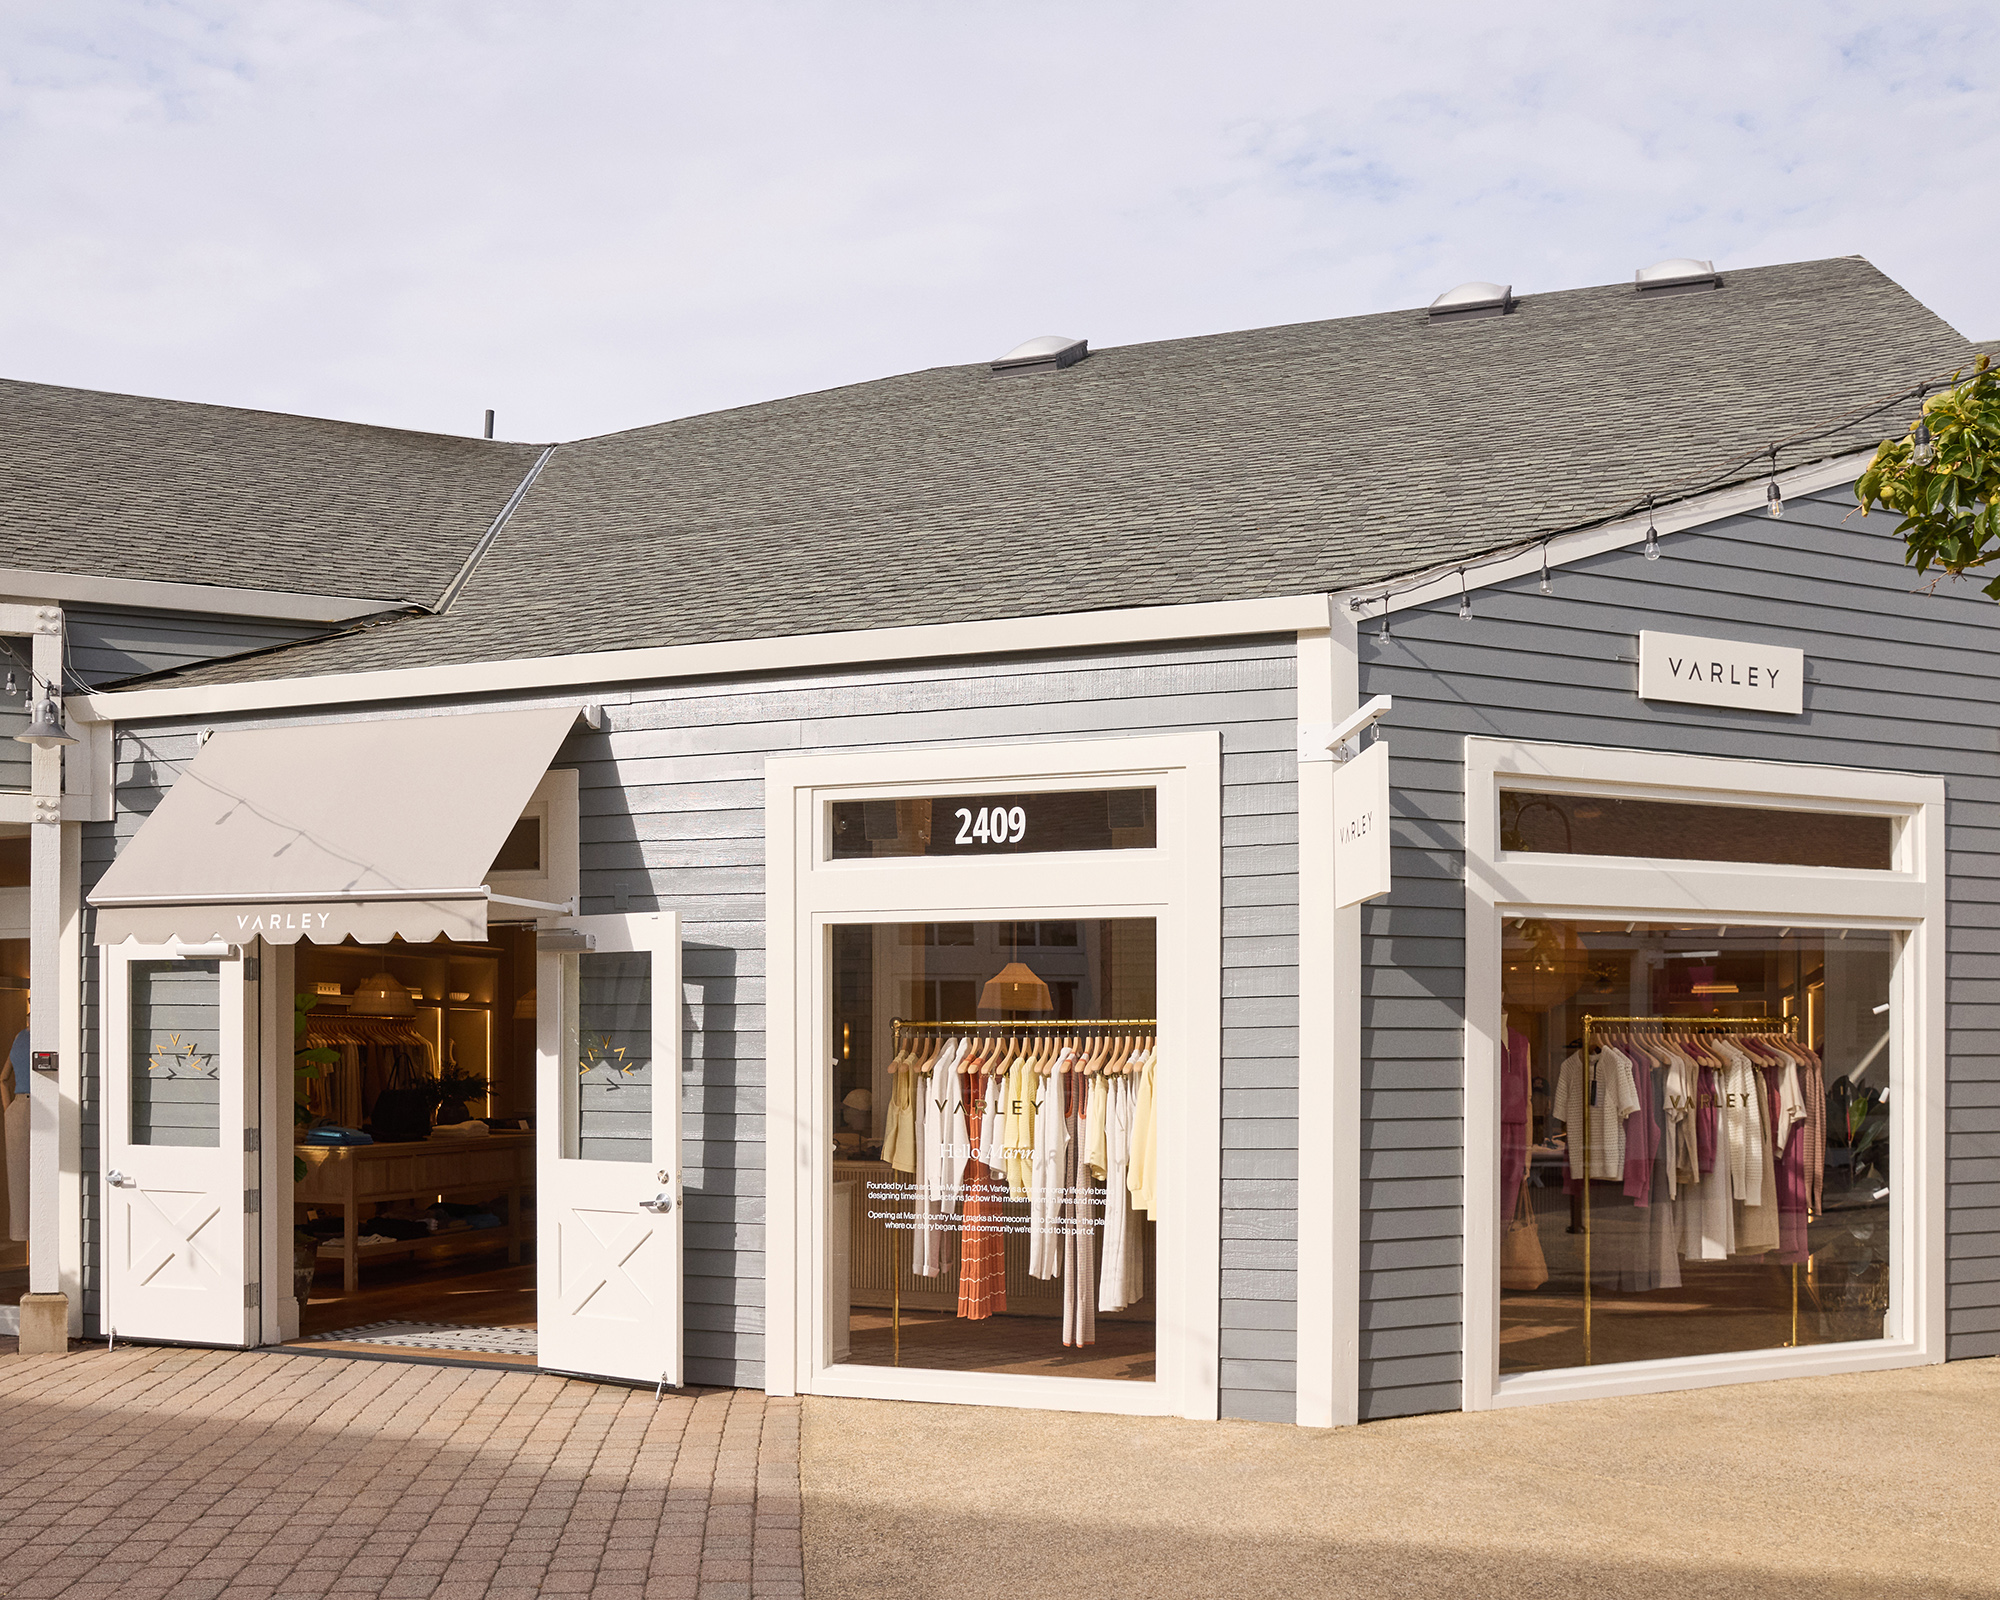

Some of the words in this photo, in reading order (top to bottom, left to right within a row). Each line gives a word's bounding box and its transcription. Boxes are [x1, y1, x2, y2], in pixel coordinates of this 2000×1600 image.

[1668, 657, 1780, 689] VARLEY
[954, 806, 1027, 845] 2409
[1339, 811, 1373, 844] VARLEY
[236, 912, 330, 930] VARLEY
[934, 1099, 1044, 1116] VARLEY
[1669, 1093, 1750, 1109] VARLEY
[940, 1143, 980, 1160] Hello
[866, 1181, 895, 1190] Founded
[895, 1182, 904, 1192] by
[965, 1184, 972, 1192] in
[972, 1184, 990, 1193] 2014,
[990, 1185, 1010, 1194] Varley
[868, 1191, 900, 1202] designing
[991, 1195, 1002, 1203] the
[1003, 1195, 1029, 1203] modern
[1057, 1197, 1073, 1205] lives
[868, 1210, 895, 1220] Opening
[903, 1211, 921, 1220] Marin
[949, 1213, 965, 1221] Mart
[992, 1214, 1034, 1224] homecomin
[1082, 1217, 1093, 1226] the
[885, 1221, 905, 1230] where
[935, 1223, 957, 1232] began,
[976, 1225, 1013, 1234] community
[1054, 1227, 1061, 1235] to
